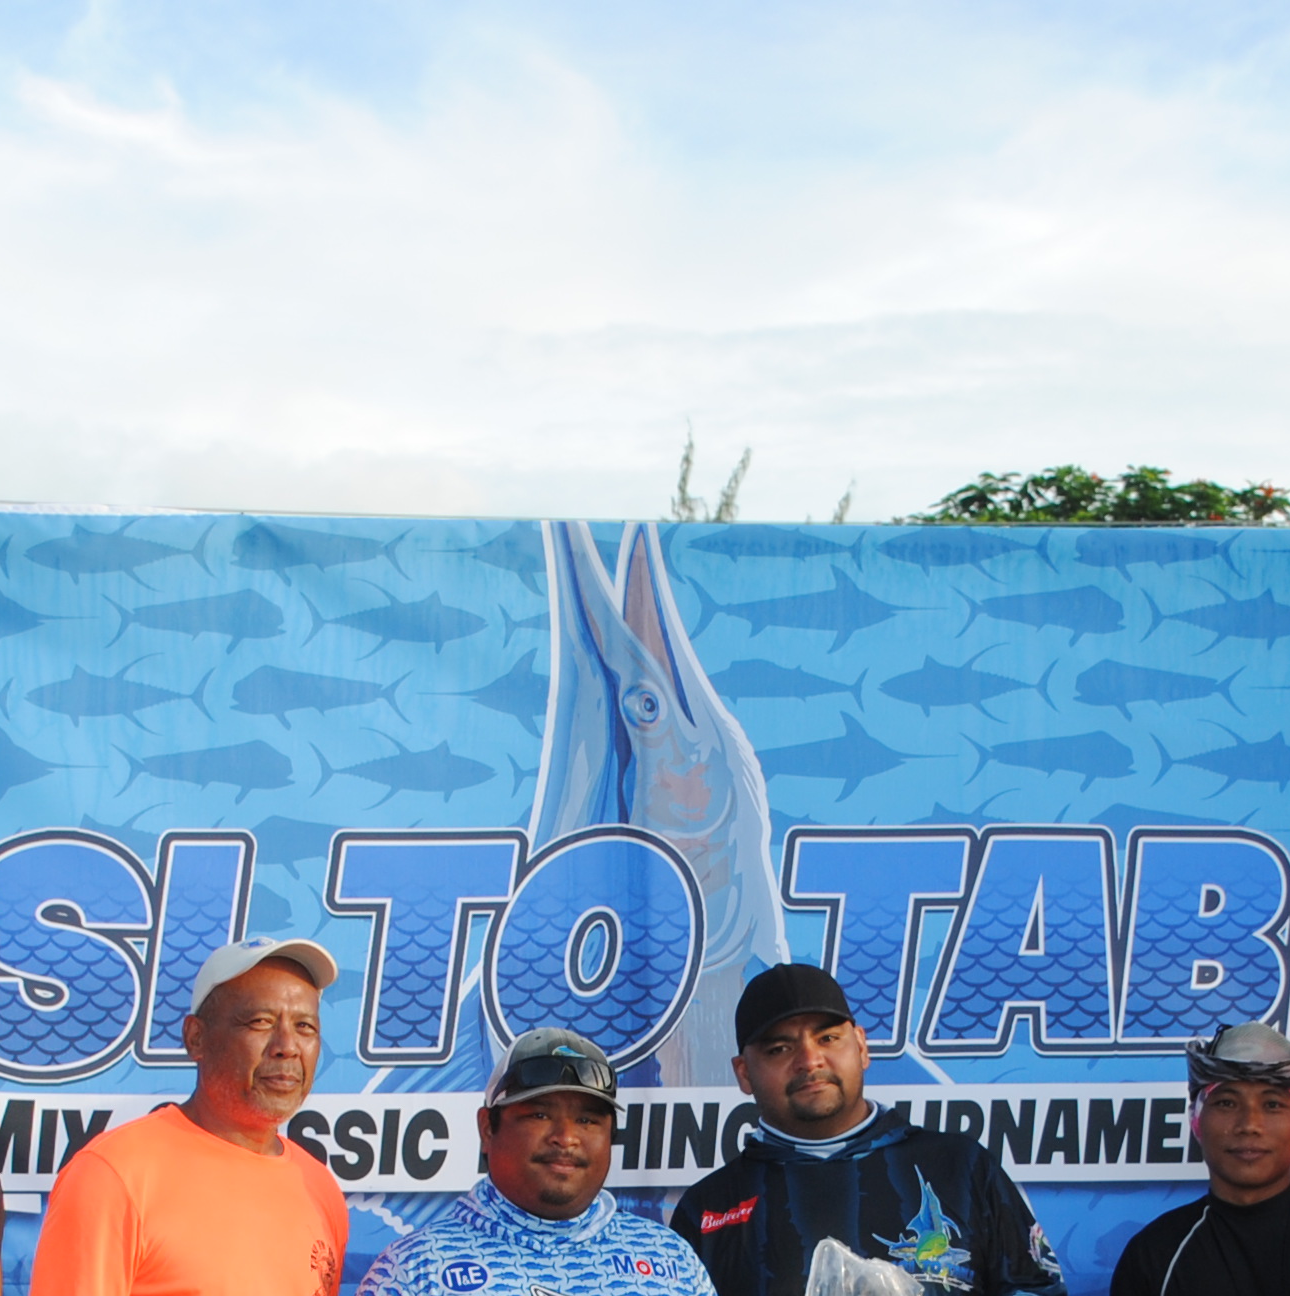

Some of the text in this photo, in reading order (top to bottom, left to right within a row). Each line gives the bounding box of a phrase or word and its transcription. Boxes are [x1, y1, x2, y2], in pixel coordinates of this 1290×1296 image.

[326, 826, 704, 1080] TO
[446, 1266, 483, 1288] IT&E
[611, 1254, 678, 1280] Mobil
